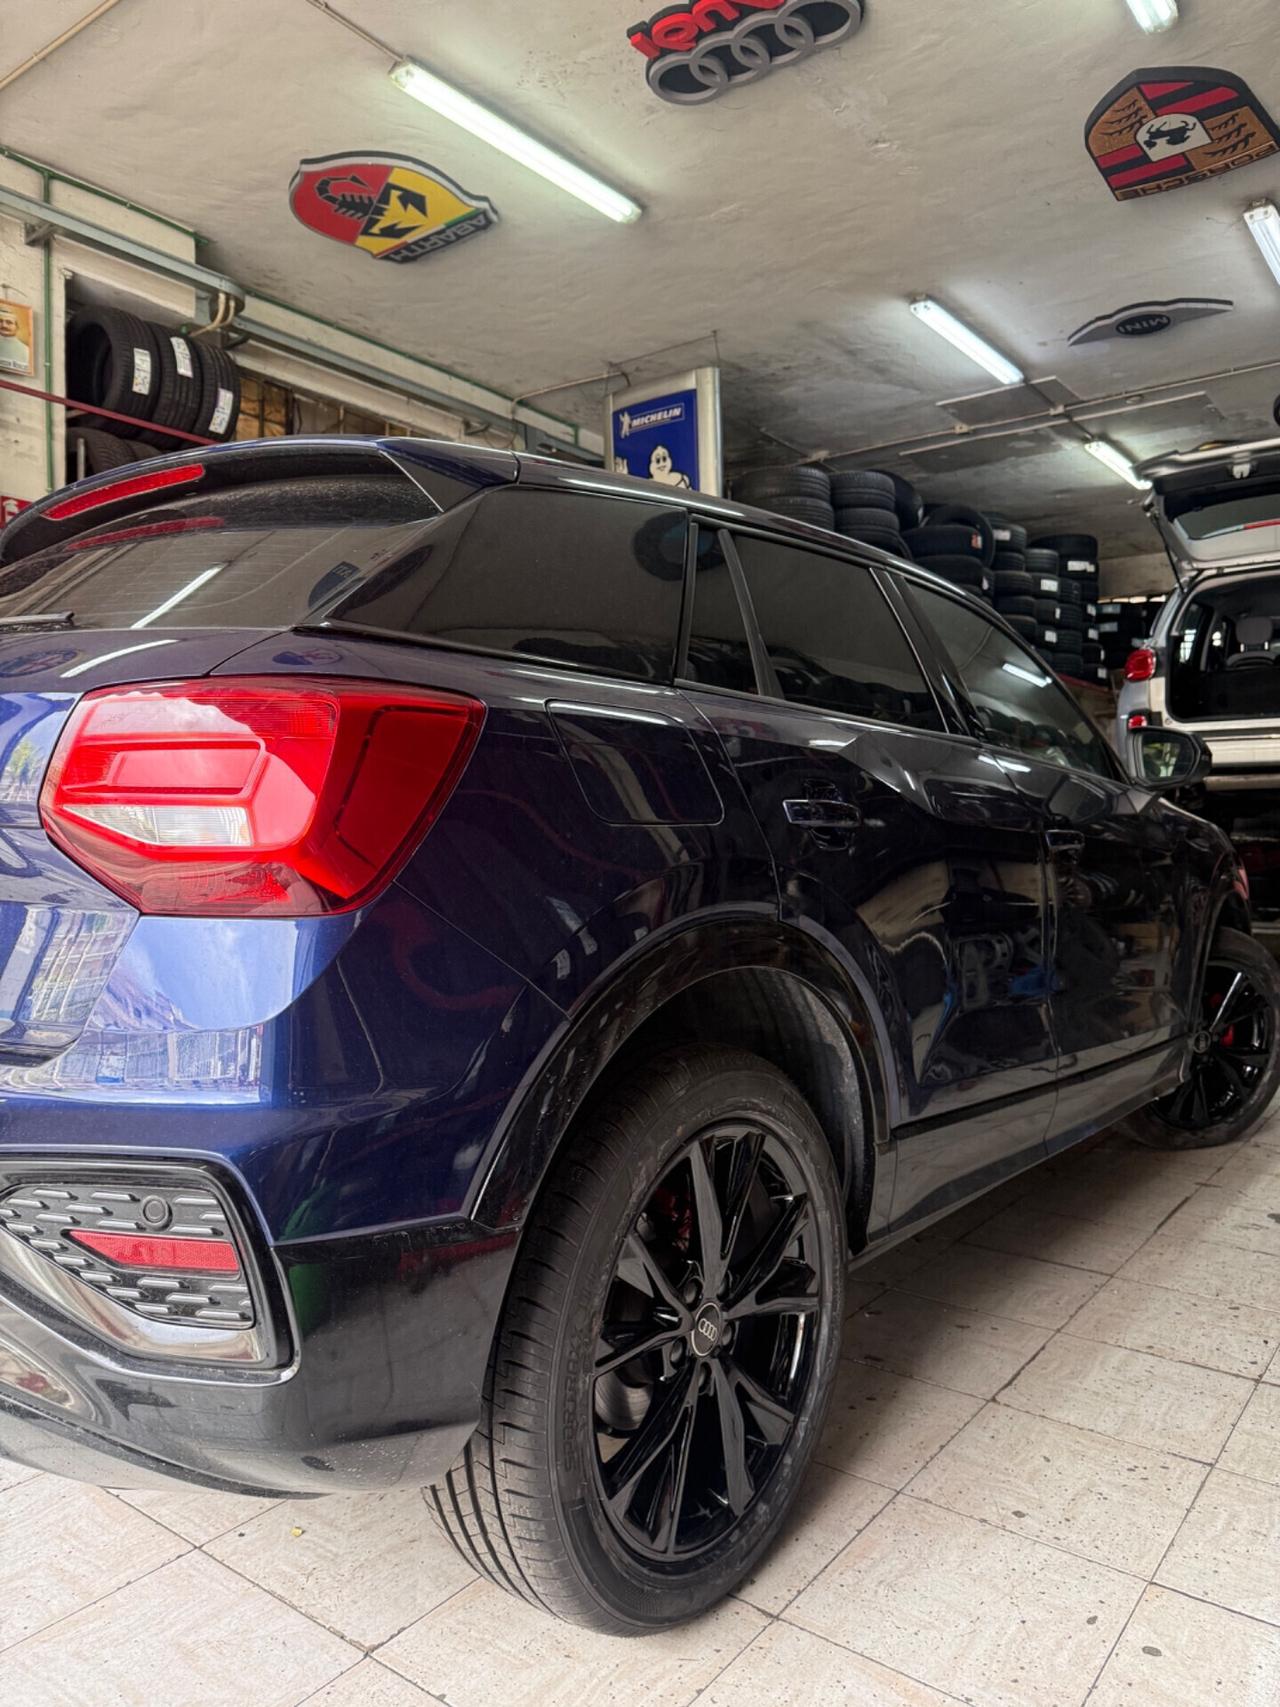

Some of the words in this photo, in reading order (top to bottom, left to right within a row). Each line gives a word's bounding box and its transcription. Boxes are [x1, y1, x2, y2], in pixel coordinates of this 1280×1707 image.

[630, 0, 787, 58] udi
[1118, 142, 1279, 200] PORSCHE
[388, 214, 487, 261] ABARTH
[1118, 316, 1169, 333] MINI
[631, 407, 682, 428] MICHELIN
